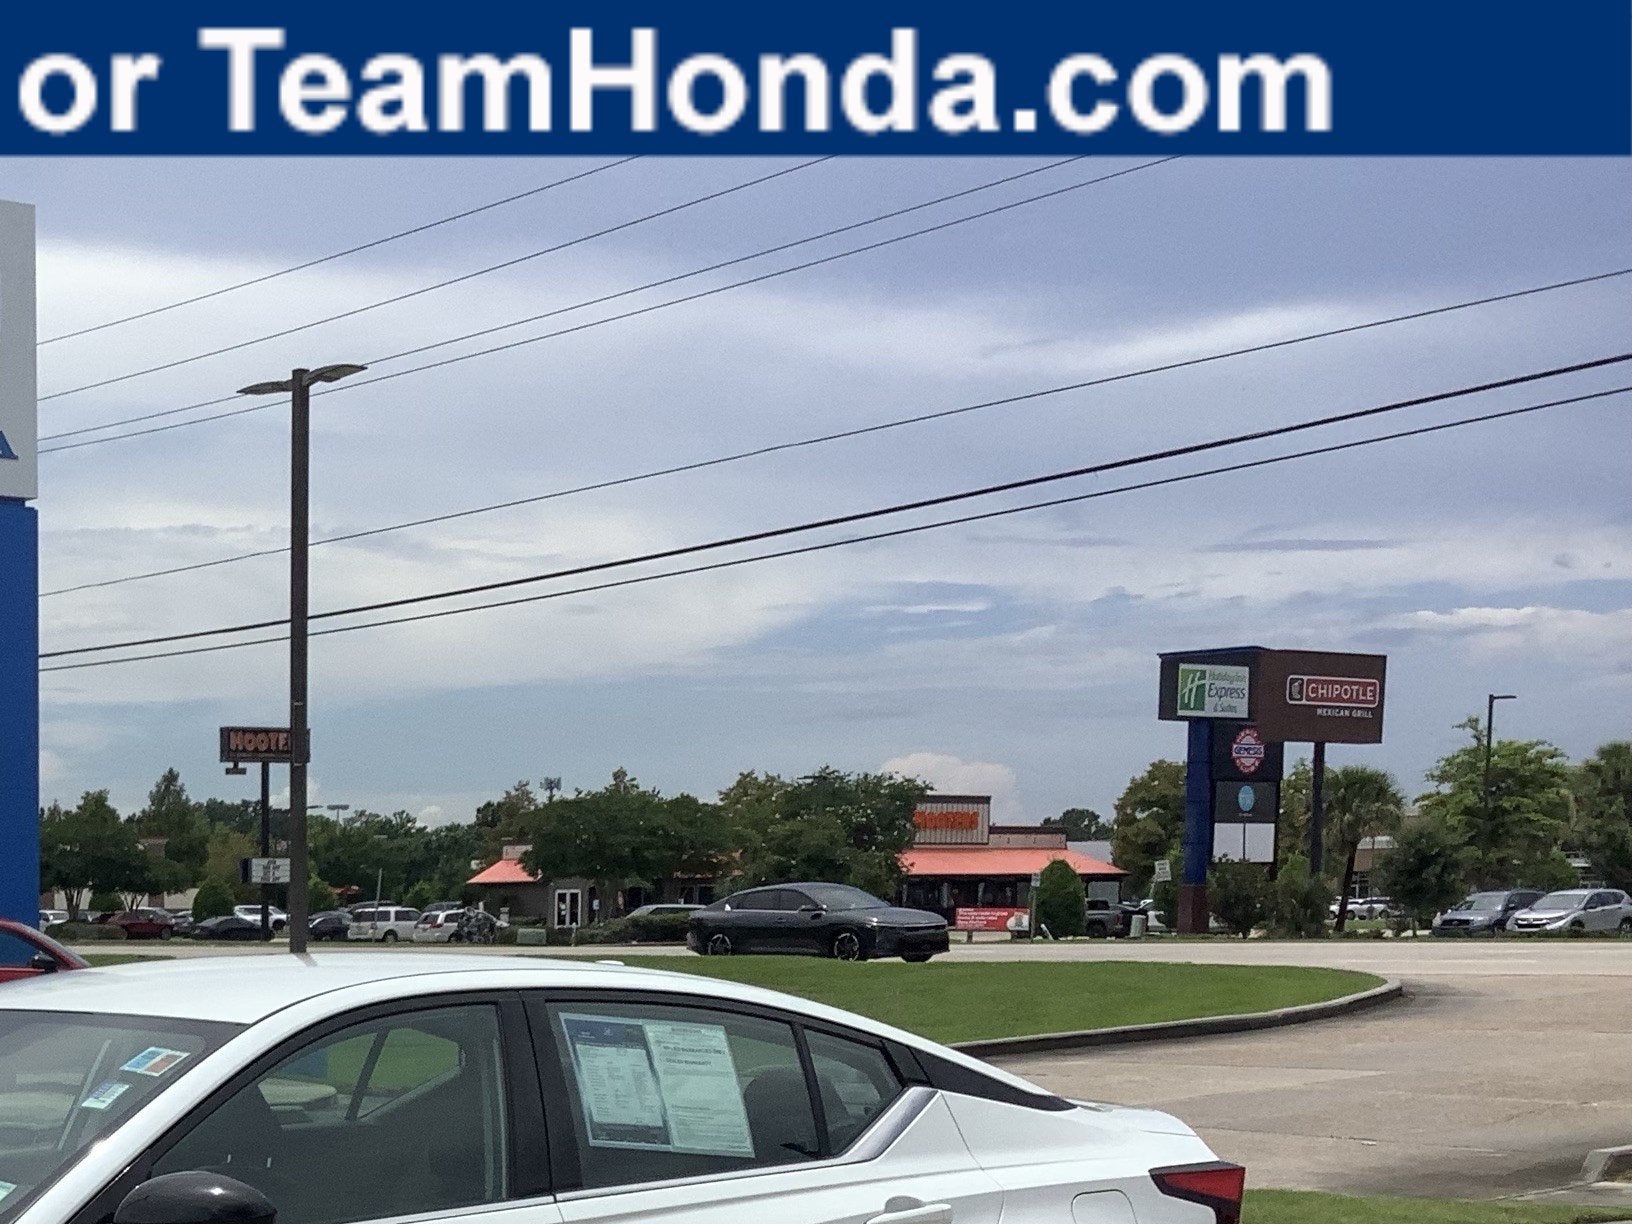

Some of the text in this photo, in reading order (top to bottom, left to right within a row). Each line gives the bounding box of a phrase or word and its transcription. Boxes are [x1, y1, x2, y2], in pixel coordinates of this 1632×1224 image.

[1208, 682, 1246, 700] Express
[1308, 683, 1375, 700] CHIPOTLE
[1316, 708, 1373, 718] MEXICAN GRILL
[229, 730, 289, 751] HOOTE
